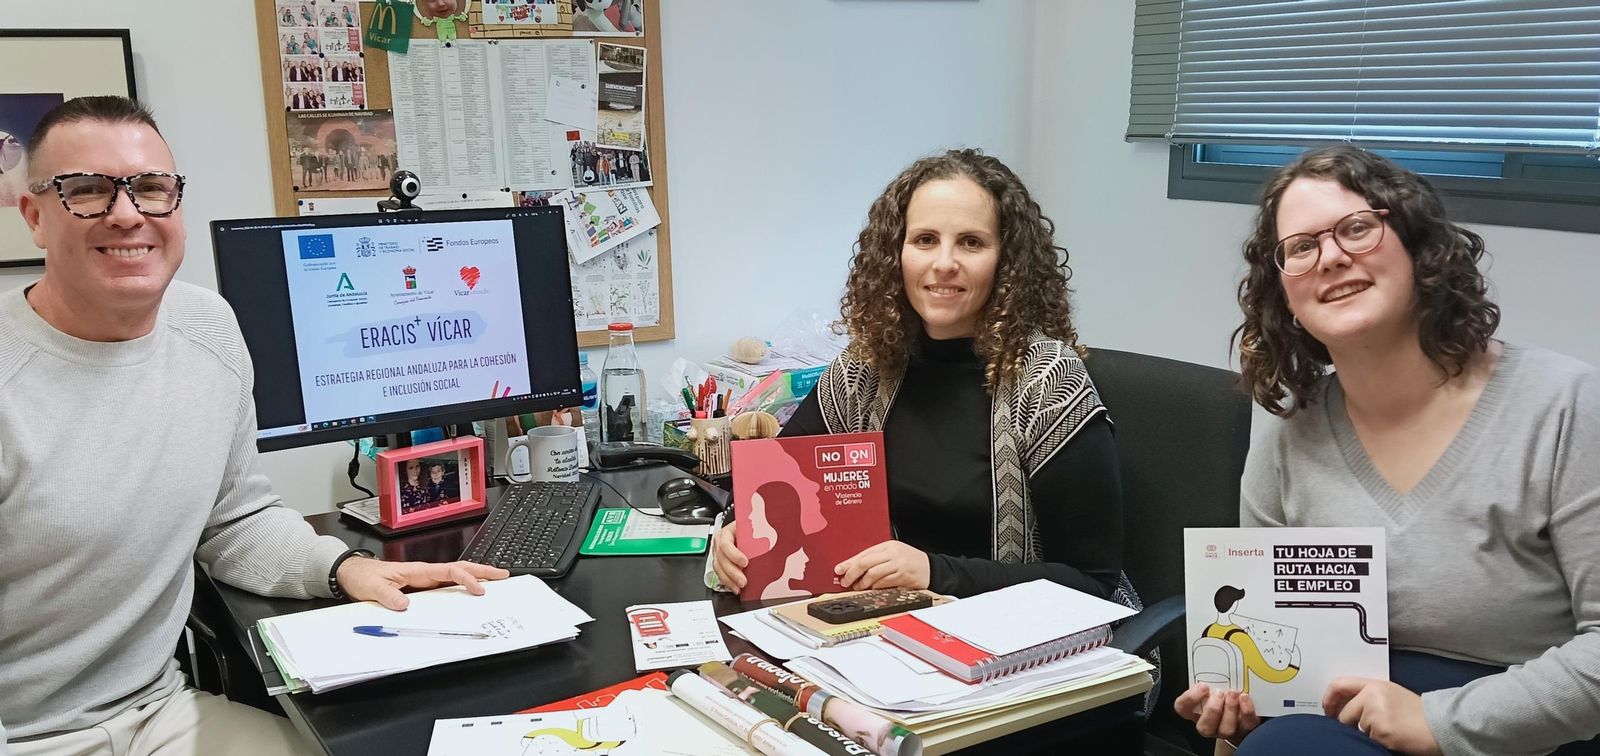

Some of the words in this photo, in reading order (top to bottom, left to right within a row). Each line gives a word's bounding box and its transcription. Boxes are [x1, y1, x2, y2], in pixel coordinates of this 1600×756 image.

[446, 239, 469, 247] Fondos
[470, 238, 499, 246] Europeos
[427, 316, 473, 343] VÍCAR
[315, 371, 365, 387] ESTRATEGIA
[366, 366, 406, 381] REGIONAL
[407, 361, 448, 376] ANDALUZA
[449, 359, 469, 371] PARA
[470, 358, 479, 368] LA
[480, 352, 517, 367] COHESIÓN
[382, 387, 388, 398] E
[389, 379, 433, 397] INCLUSIÓN
[433, 378, 461, 391] SOCIAL
[822, 451, 840, 462] NO
[850, 449, 869, 464] ON
[823, 470, 869, 483] MUJERES
[836, 482, 857, 490] modo
[858, 480, 870, 489] ON
[1228, 548, 1264, 557] Inserta
[1276, 548, 1294, 558] TU
[1298, 548, 1335, 558] HOJA
[1338, 548, 1357, 558] DE
[1276, 564, 1313, 574] RUTA
[1315, 564, 1356, 574] HACIA
[1277, 580, 1294, 591] EL
[1297, 580, 1353, 591] EMPLEO
